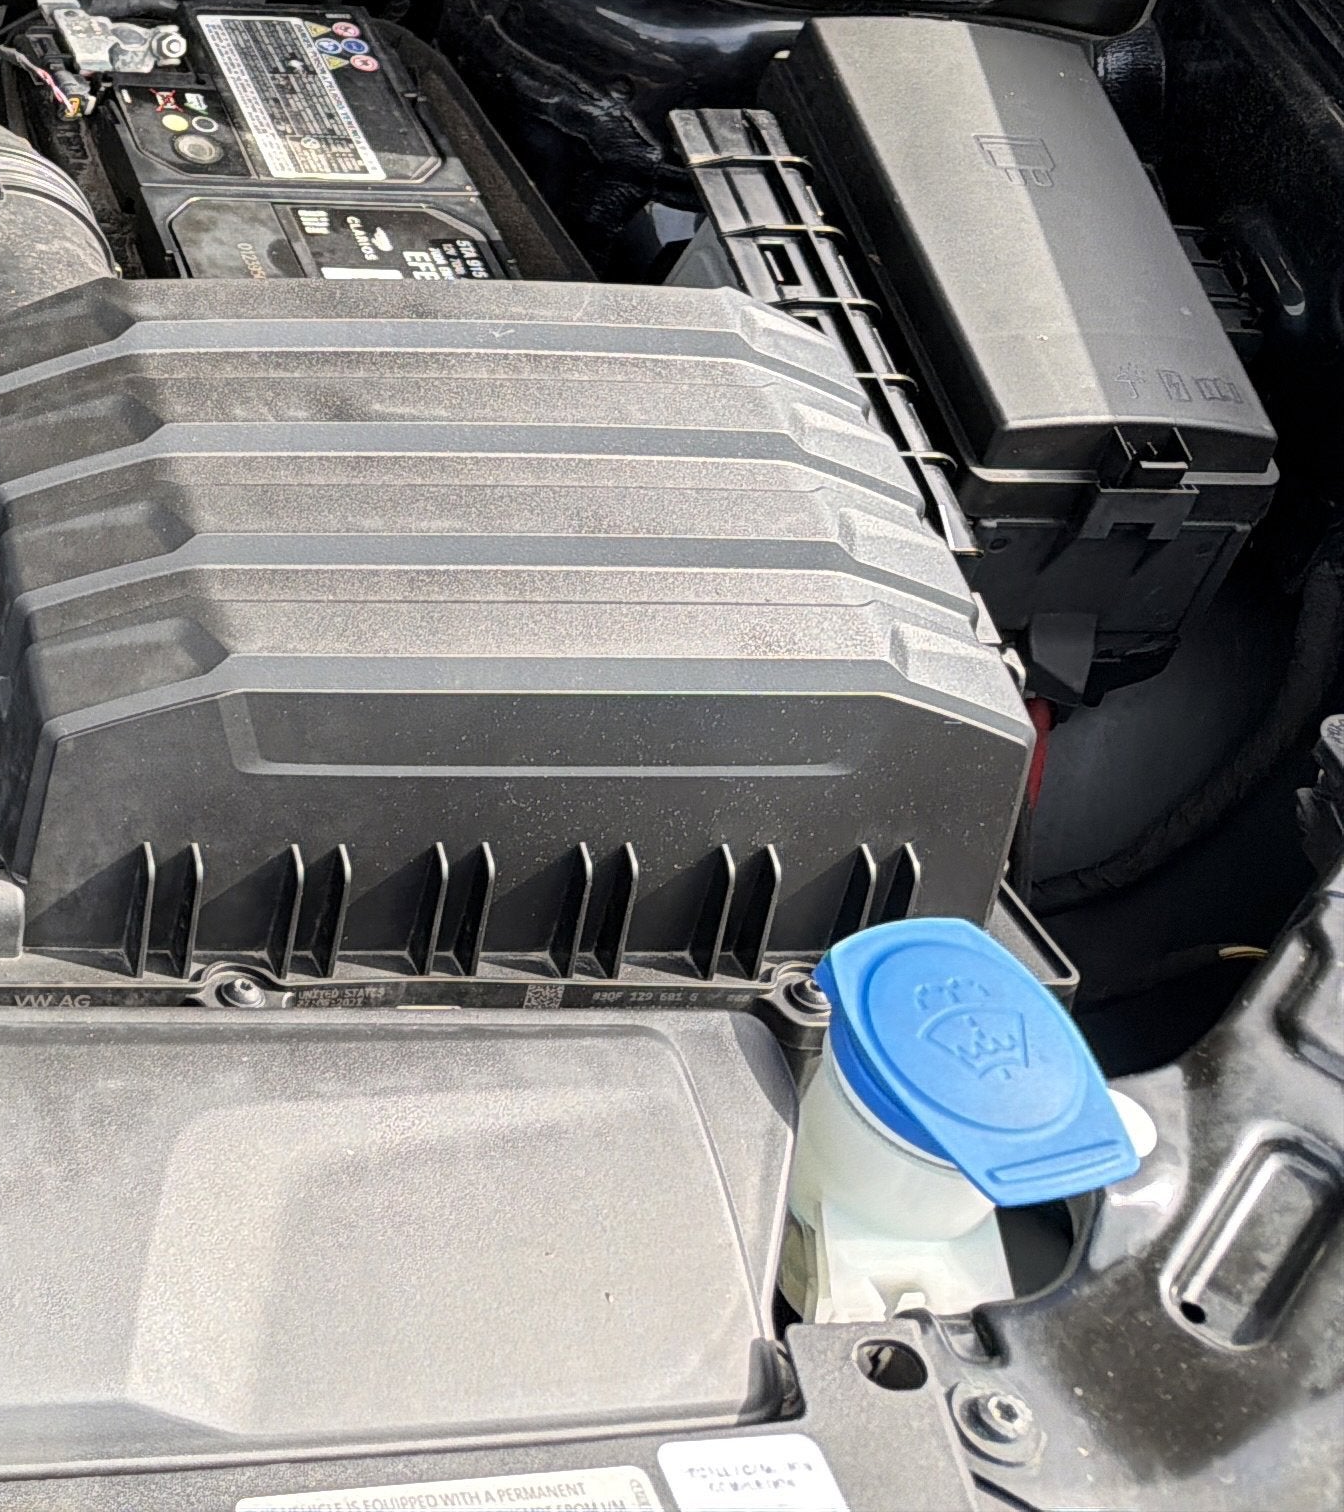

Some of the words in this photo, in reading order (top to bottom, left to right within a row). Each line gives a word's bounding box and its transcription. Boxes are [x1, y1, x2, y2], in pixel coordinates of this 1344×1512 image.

[345, 215, 379, 261] CLARIOS
[362, 1493, 437, 1510] EQUIPPED
[438, 1491, 482, 1507] WITH
[484, 1490, 497, 1504] A
[497, 1482, 587, 1503] PERMANENT
